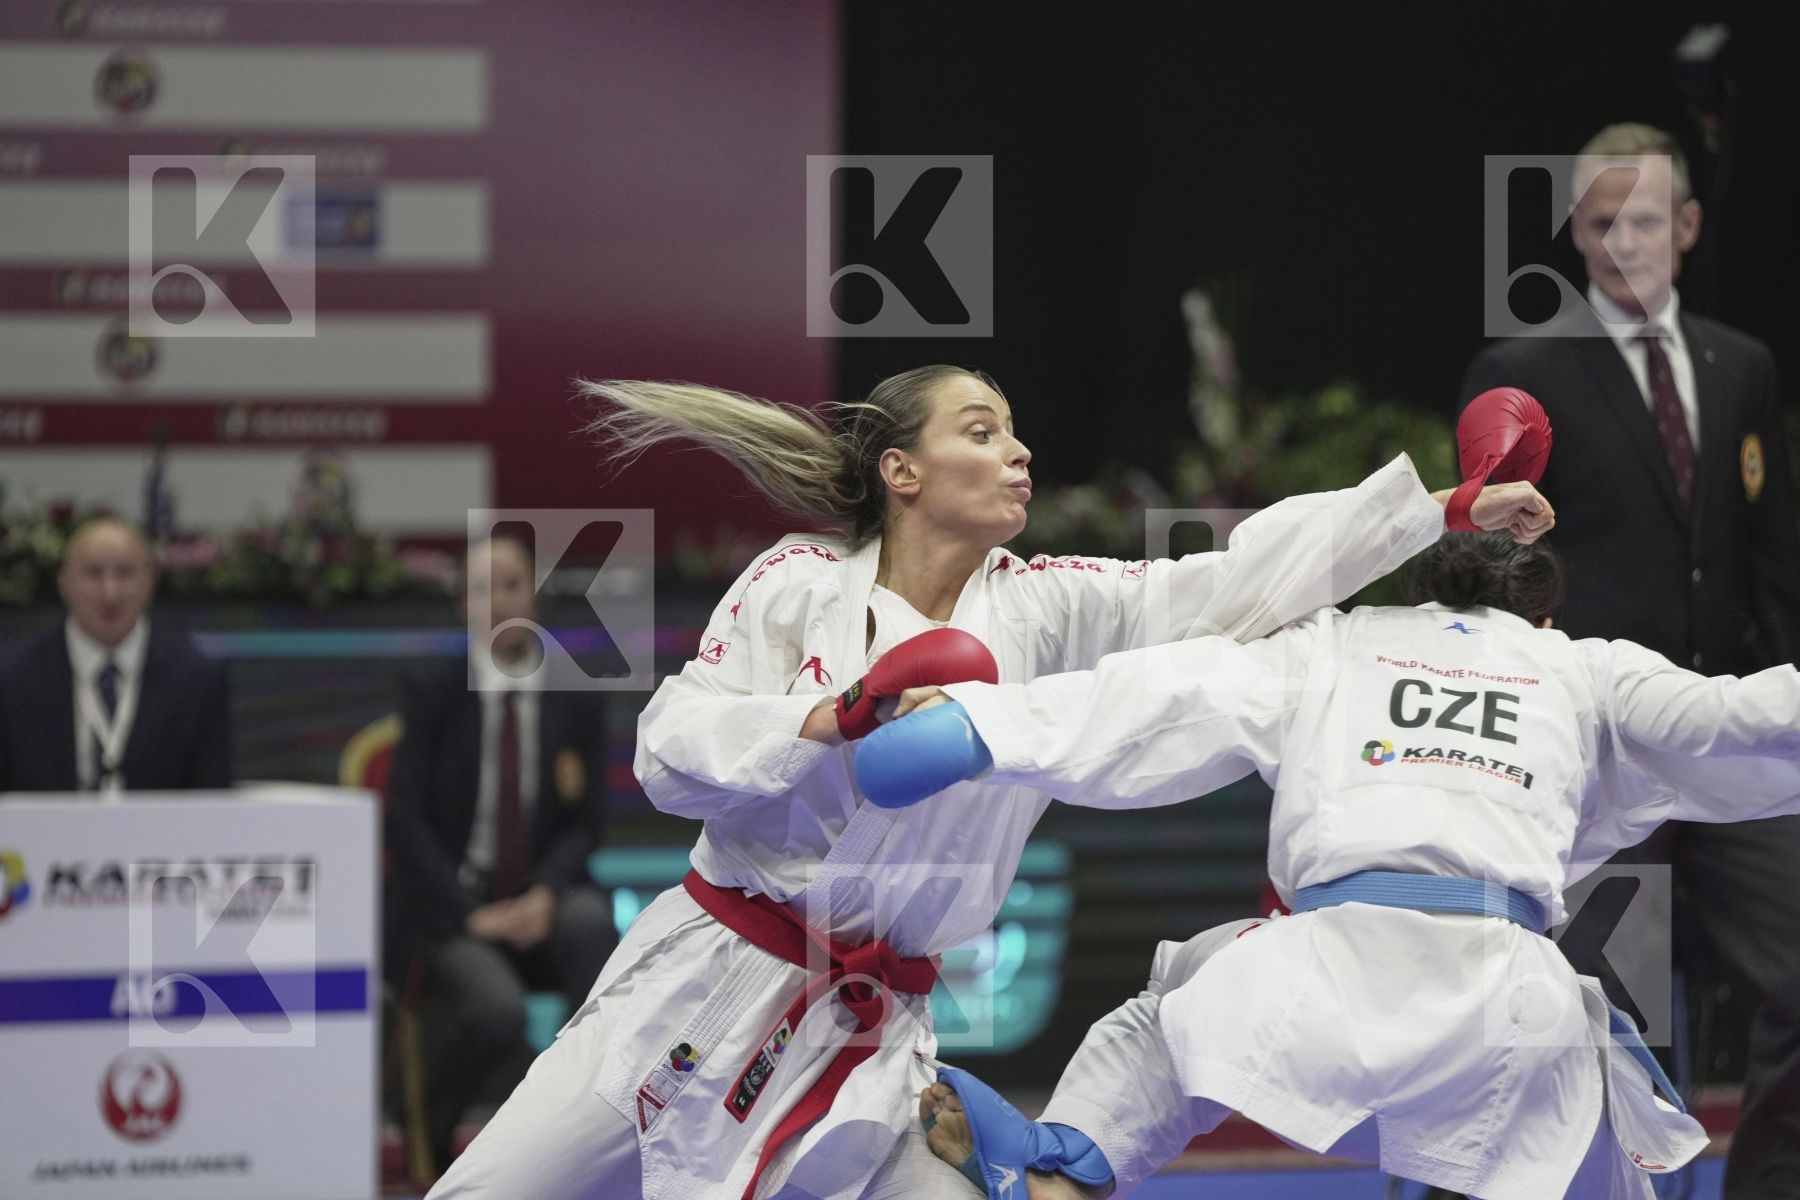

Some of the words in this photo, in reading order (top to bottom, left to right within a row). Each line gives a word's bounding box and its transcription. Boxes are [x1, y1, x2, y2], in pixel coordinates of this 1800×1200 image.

[1376, 655, 1418, 668] WORLD
[1421, 663, 1465, 678] KARATE
[1469, 670, 1540, 686] FEDERATION
[1389, 678, 1521, 745] CZE
[1400, 758, 1464, 768] PREMIER
[1469, 763, 1523, 785] LEAGUE
